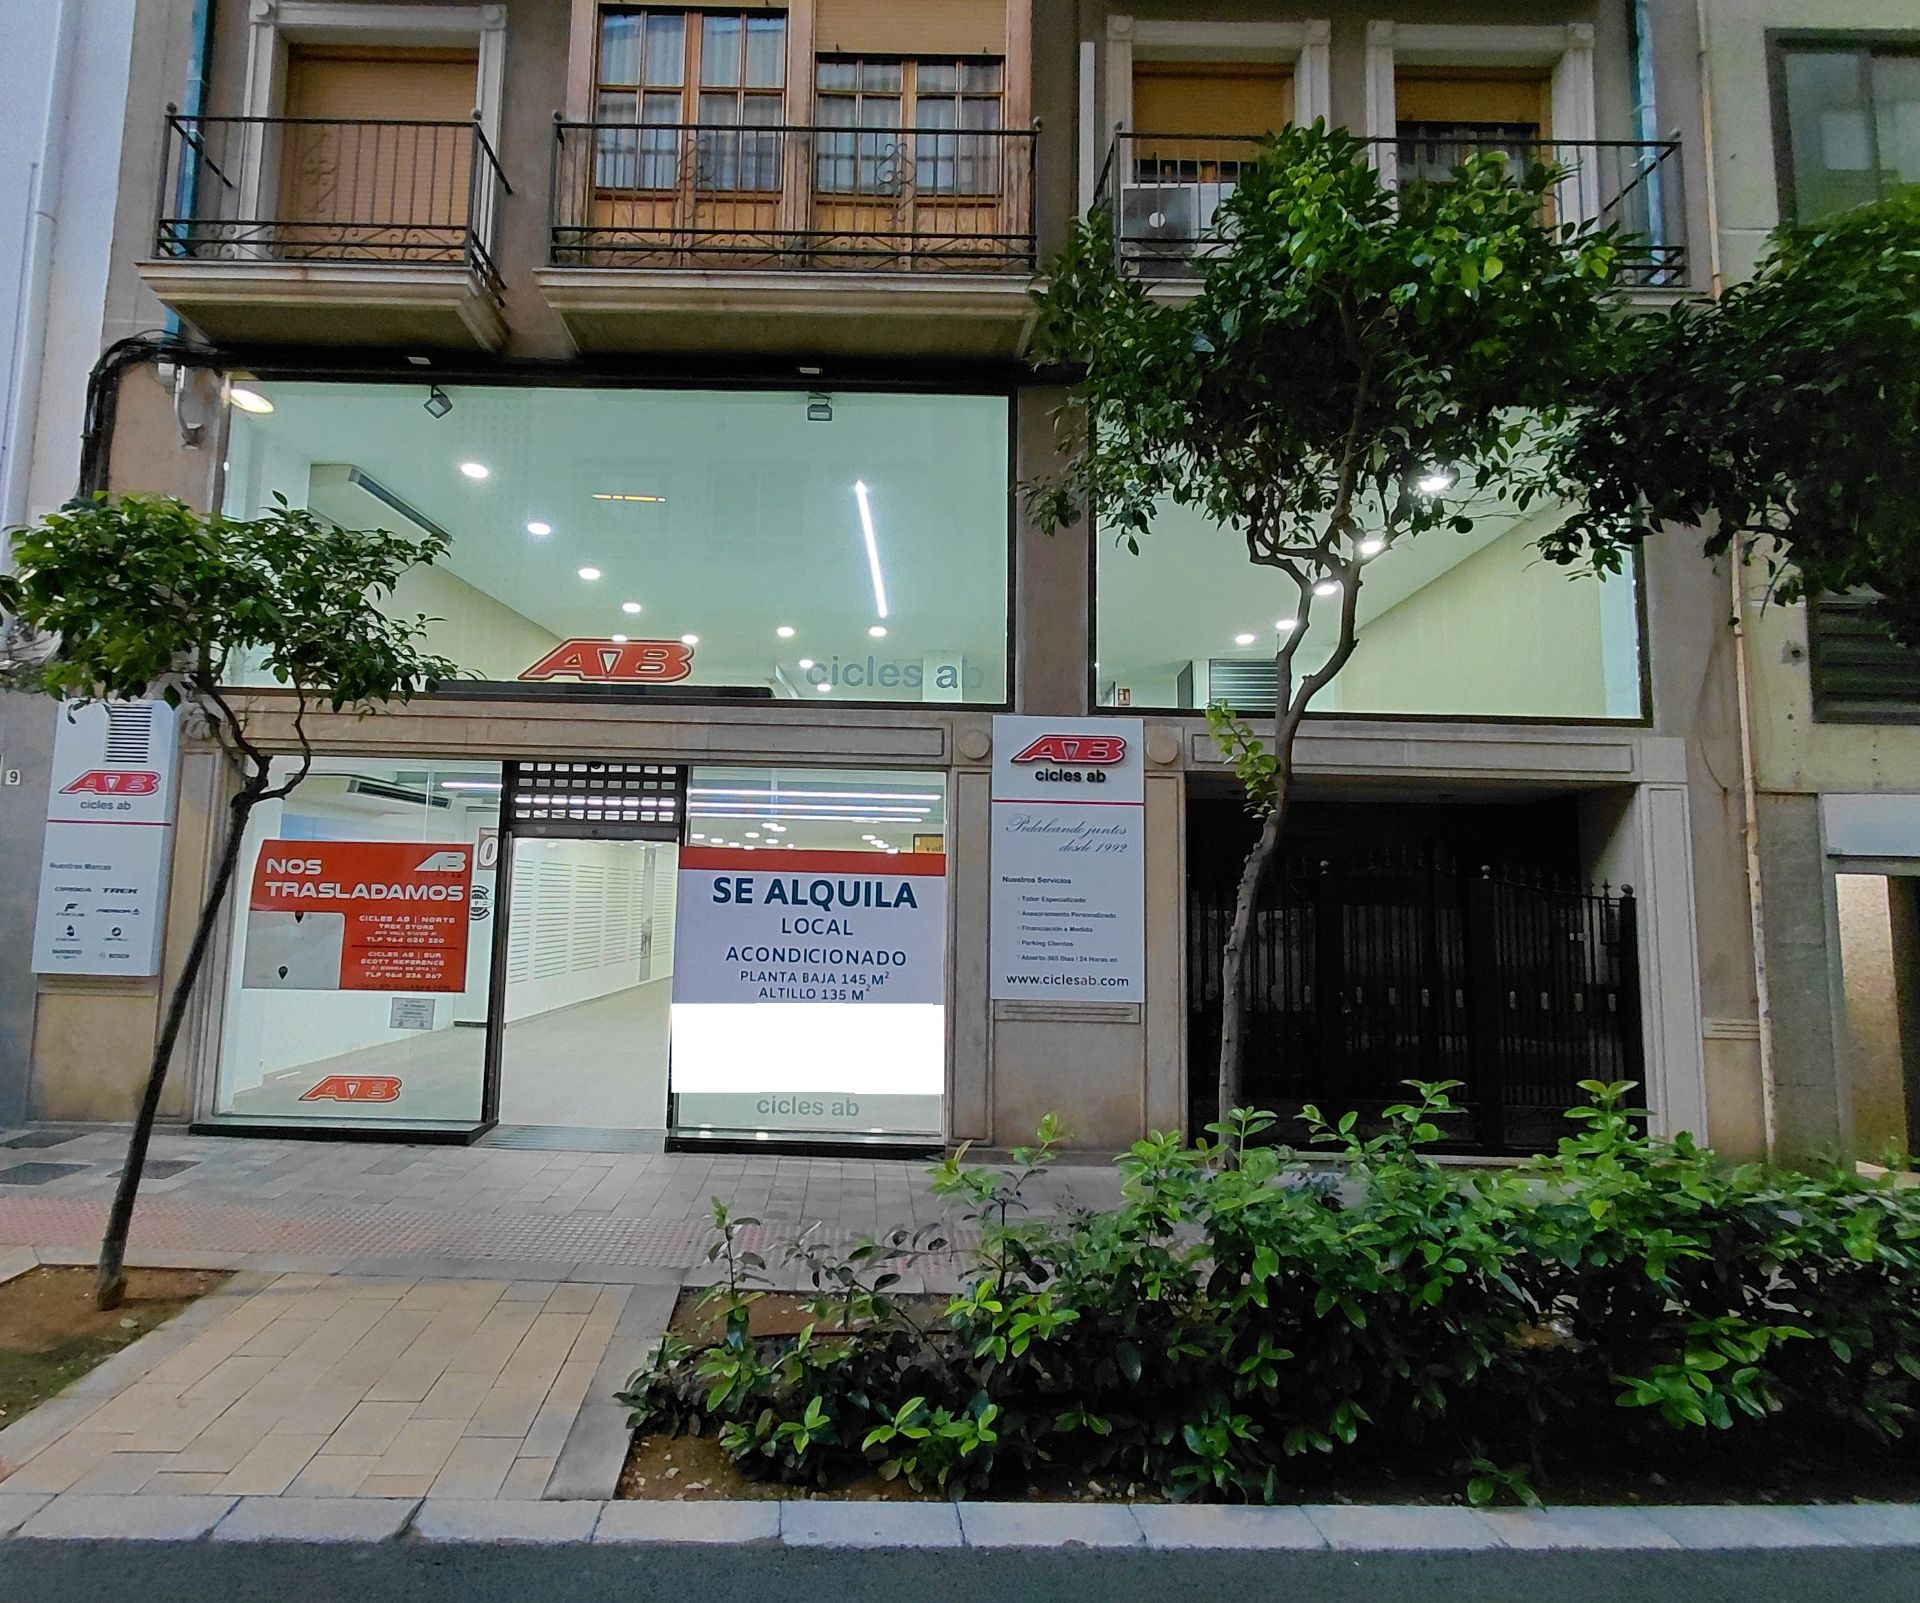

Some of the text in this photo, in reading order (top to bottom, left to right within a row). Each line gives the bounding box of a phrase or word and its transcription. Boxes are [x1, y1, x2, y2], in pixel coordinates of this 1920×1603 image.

[517, 638, 695, 683] AB
[806, 655, 985, 690] cicles ab
[1010, 734, 1127, 764] AB
[9, 770, 18, 783] 9
[58, 769, 162, 796] AB
[1034, 768, 1106, 783] cicles ab
[80, 799, 132, 811] cicles ab
[1005, 813, 1127, 839] Pedaleando juntos
[1059, 838, 1128, 853] desde 1992
[265, 858, 322, 875] NOS
[1002, 876, 1072, 885] Nuestros Servicios
[101, 887, 139, 895] TREK
[264, 881, 465, 902] TRASLADAMOS
[712, 876, 918, 911] SE ALQUILA
[421, 916, 456, 924] NORTE
[781, 917, 854, 936] LOCAL
[393, 958, 445, 966] REFERENCE
[726, 946, 907, 967] ACONDICIONADO
[740, 971, 797, 984] PLANTA
[802, 972, 836, 985] BAJA
[841, 972, 866, 985] 145
[1006, 973, 1129, 987] www.ciclesab.com
[758, 987, 816, 1000] ALTILLO
[821, 988, 847, 1000] 135
[298, 1075, 402, 1103] AB
[756, 1096, 860, 1117] cicles ab
